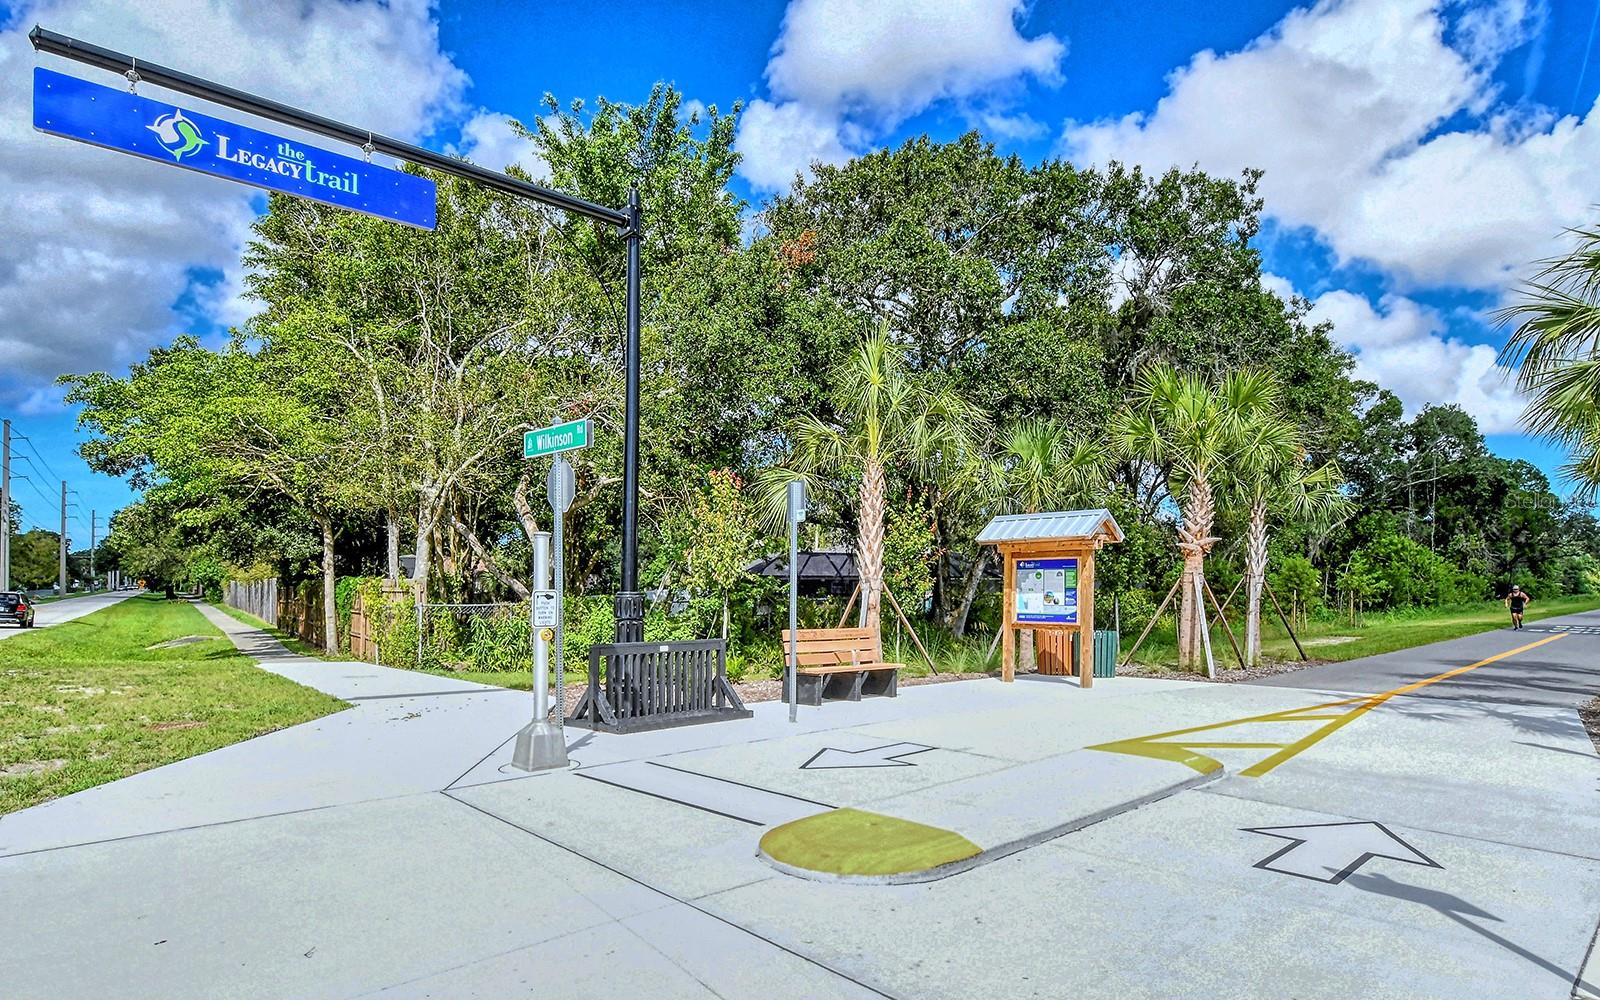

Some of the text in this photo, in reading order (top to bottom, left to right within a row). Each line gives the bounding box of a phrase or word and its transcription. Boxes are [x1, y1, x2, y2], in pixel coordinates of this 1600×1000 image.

[216, 134, 359, 195] LEGACY trail
[277, 143, 305, 161] the
[536, 424, 584, 451] Wilkinson Rd
